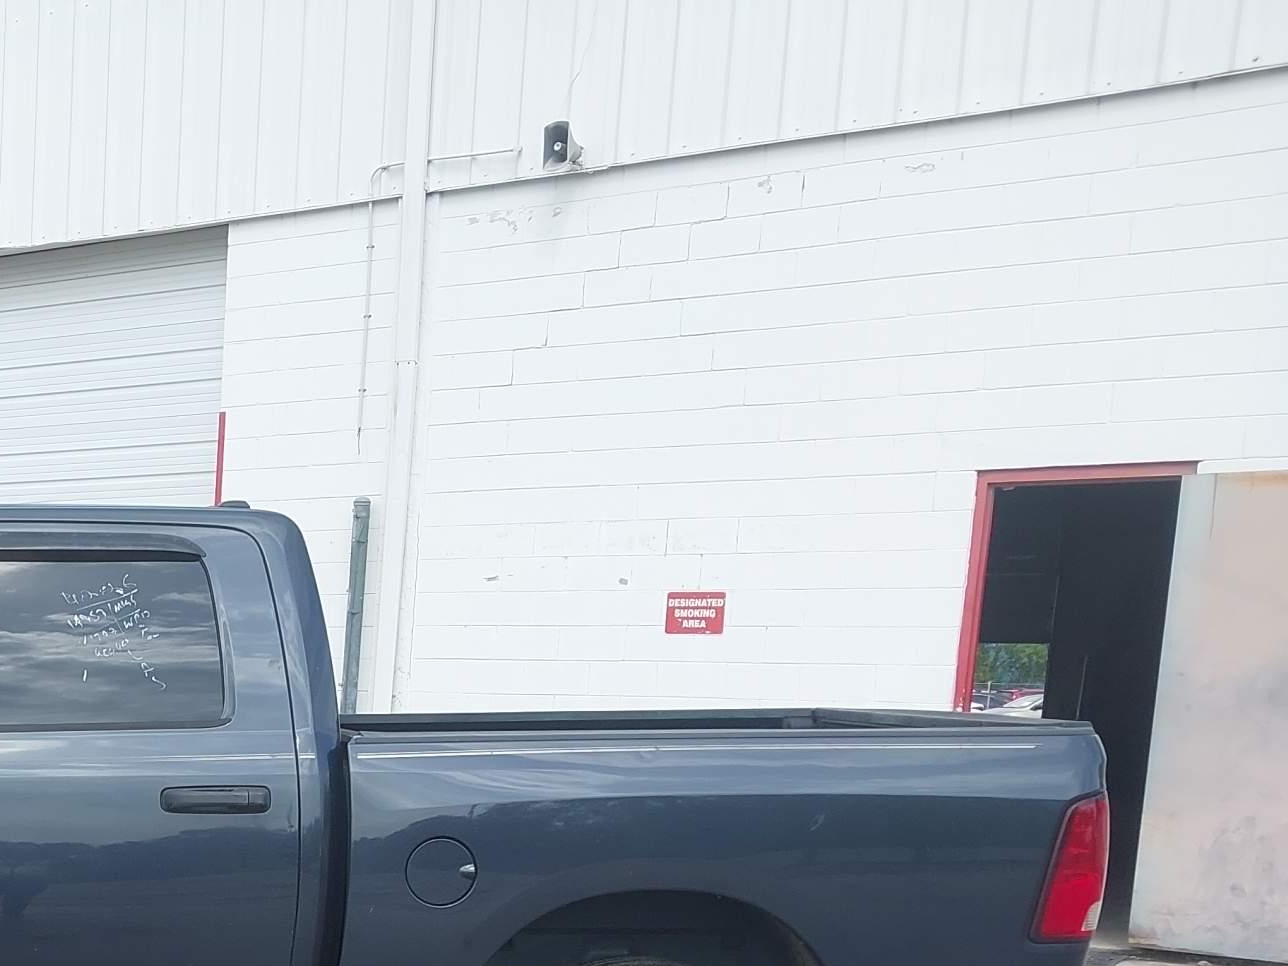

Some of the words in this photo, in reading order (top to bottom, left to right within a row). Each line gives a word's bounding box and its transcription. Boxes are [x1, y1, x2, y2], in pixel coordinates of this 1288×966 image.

[668, 598, 724, 607] DESIGNATED
[674, 609, 716, 618] SMOKING
[682, 620, 706, 628] AREA
